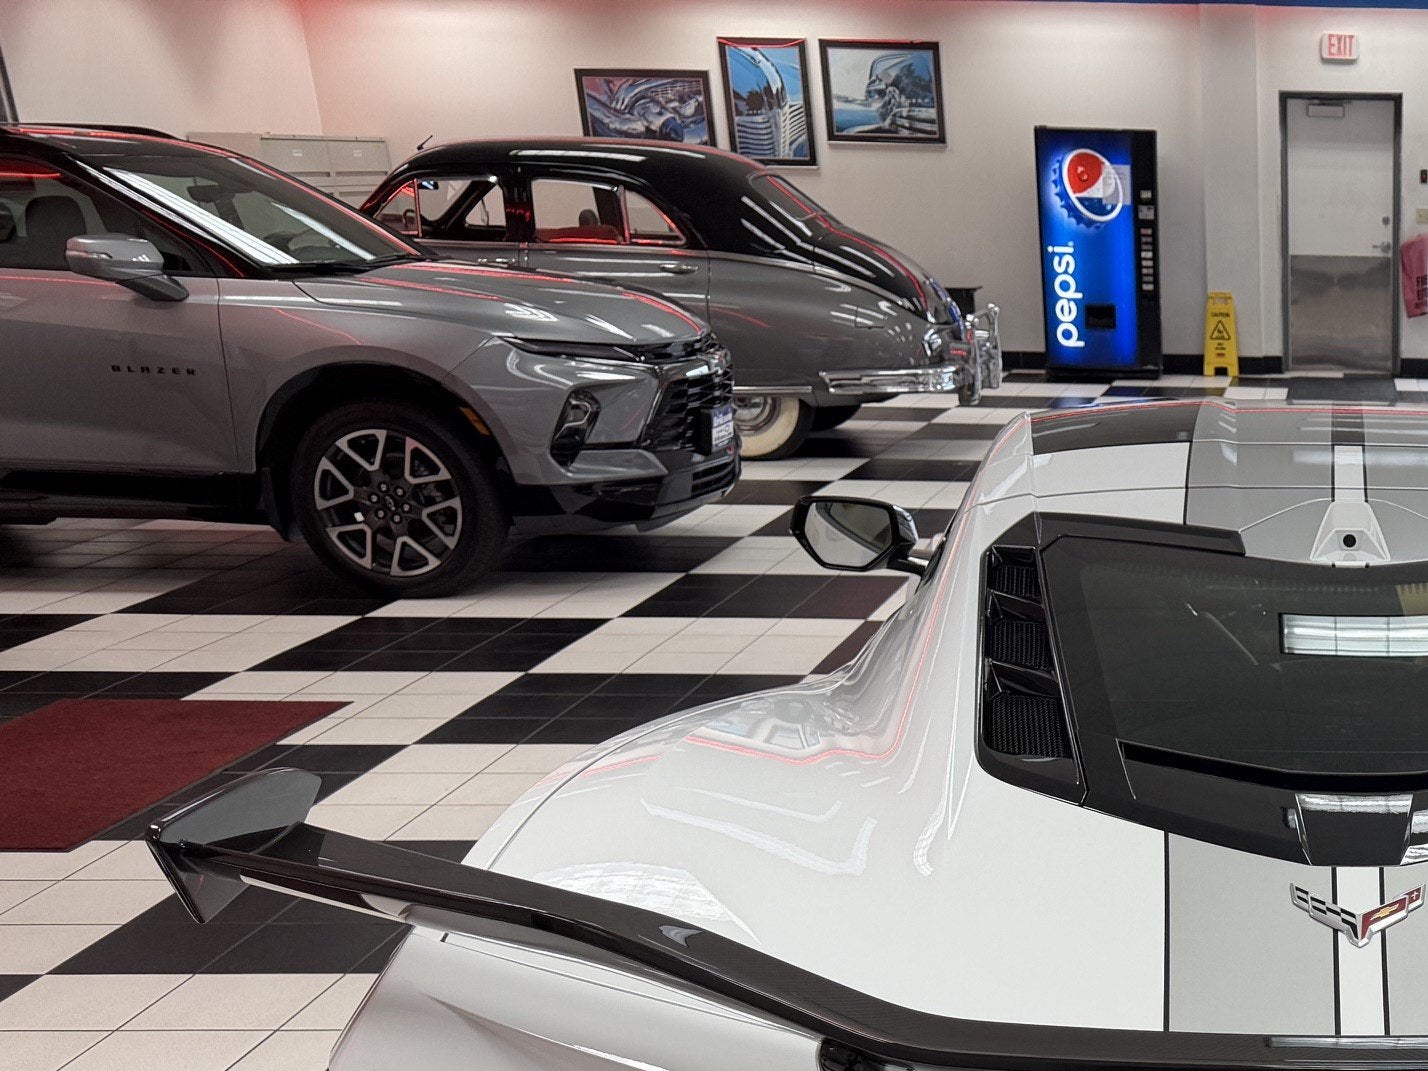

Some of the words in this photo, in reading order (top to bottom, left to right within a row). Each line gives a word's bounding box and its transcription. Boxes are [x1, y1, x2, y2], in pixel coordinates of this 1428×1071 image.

[1328, 34, 1355, 57] EXIT
[1047, 244, 1085, 348] pepsi
[111, 365, 195, 376] BLAZER
